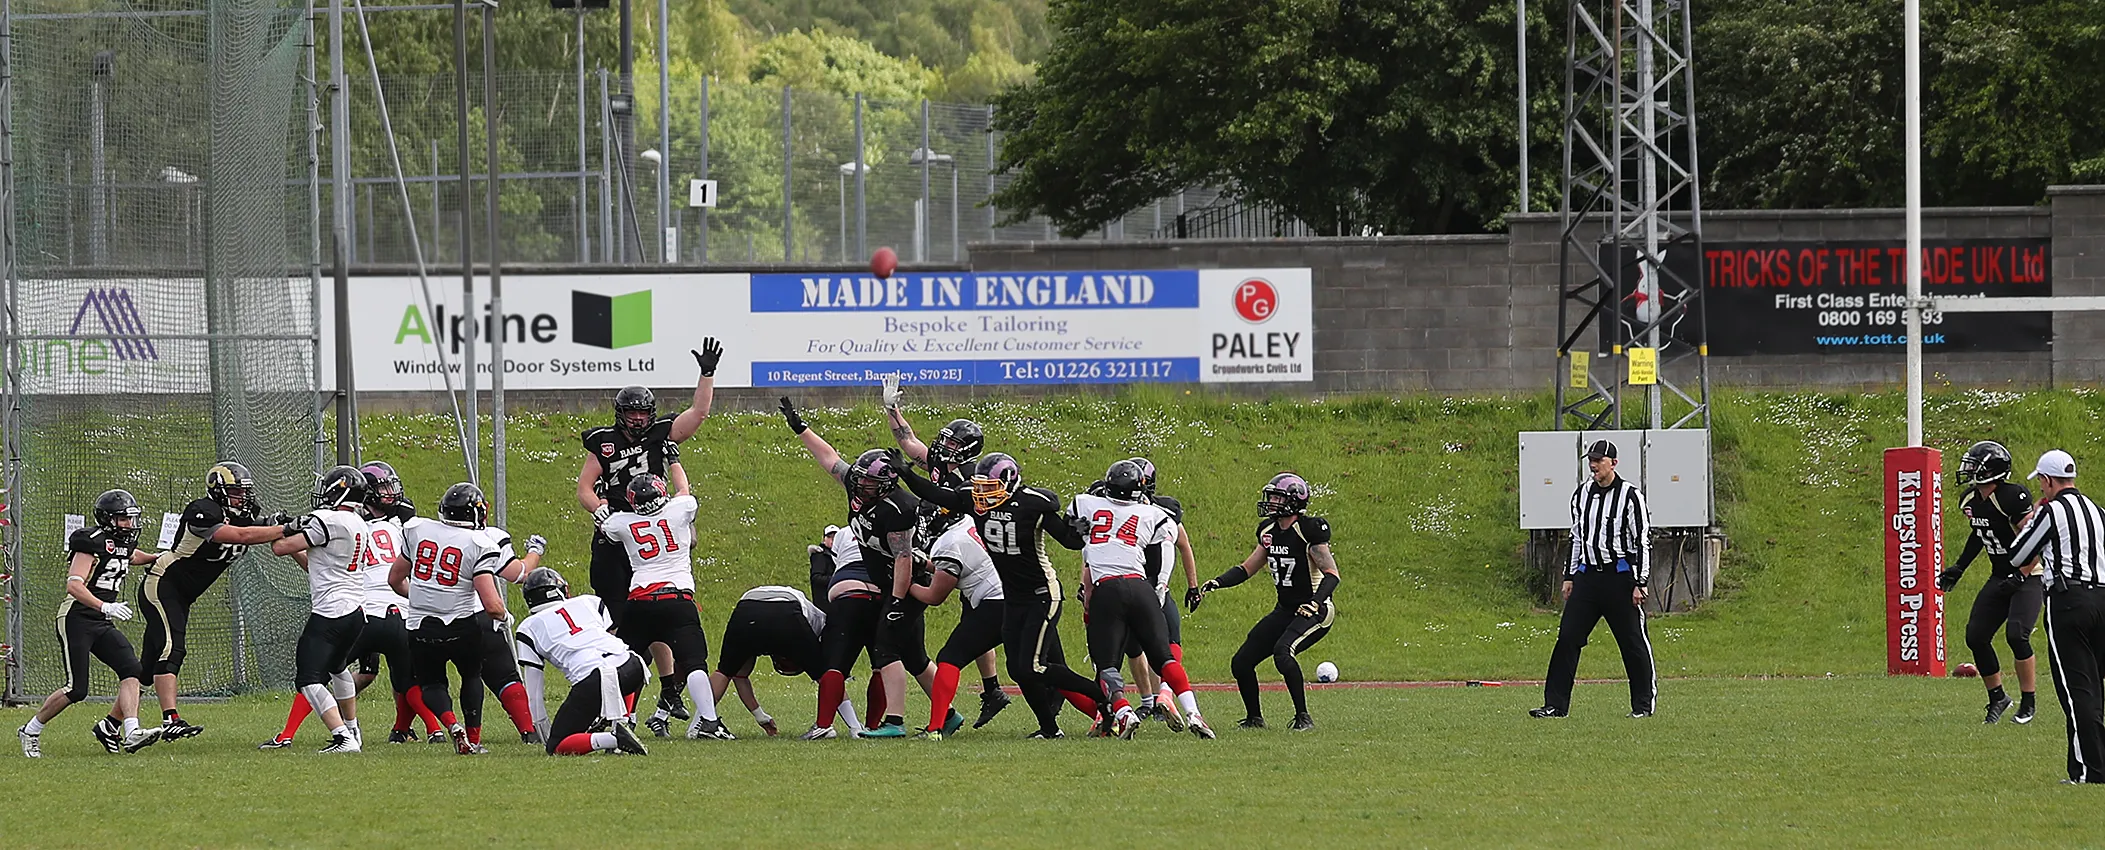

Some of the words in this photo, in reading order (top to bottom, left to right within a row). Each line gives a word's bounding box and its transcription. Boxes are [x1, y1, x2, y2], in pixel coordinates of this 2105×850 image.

[700, 183, 707, 204] 1
[1706, 249, 1791, 288] TRICKS
[1797, 249, 1829, 287] OF
[1835, 248, 1881, 286] THE
[1971, 246, 2004, 284] UK
[2010, 245, 2045, 283] Ltd
[801, 277, 908, 307] MADE
[920, 276, 963, 307] IN
[975, 275, 1155, 307] ENGLAND
[1775, 293, 1813, 309] First
[1816, 292, 1864, 309] Class
[394, 303, 558, 354] Alpine
[884, 316, 968, 336] Bespoke
[978, 315, 1068, 334] Tailoring
[1818, 311, 1861, 326] 0800
[1867, 311, 1897, 326] 169
[1901, 310, 1943, 325] 593
[807, 339, 836, 353] For
[840, 338, 897, 356] Quality
[902, 338, 918, 352] &
[924, 337, 999, 352] Excellent
[1003, 337, 1080, 351] Customer
[1085, 336, 1143, 350] Service
[1212, 332, 1300, 358] PALEY
[1816, 333, 1945, 345] www.tott.c.uk
[503, 359, 544, 373] Door
[550, 358, 622, 376] Systems
[628, 358, 654, 372] Ltd
[767, 370, 780, 381] 10
[782, 370, 822, 384] Regent
[824, 369, 862, 383] Street,
[919, 368, 940, 380] S70
[942, 368, 963, 380] 2EJ
[1001, 361, 1040, 379] Tel:
[1044, 361, 1100, 378] 01226
[1105, 360, 1172, 378] 321117
[1212, 363, 1264, 375] Groundworks
[1266, 363, 1288, 374] Civils
[1290, 362, 1302, 373] Ltd
[619, 445, 643, 459] RAMS
[990, 511, 1013, 521] RAMS
[983, 519, 1022, 556] 91
[1090, 509, 1139, 547] 24
[1892, 470, 1921, 590] Kingstone
[629, 519, 680, 561] 51
[1269, 545, 1289, 555] RAMS
[414, 539, 463, 587] 89
[555, 607, 583, 636] 1
[1900, 593, 1924, 663] Press
[1934, 593, 1945, 662] Press
